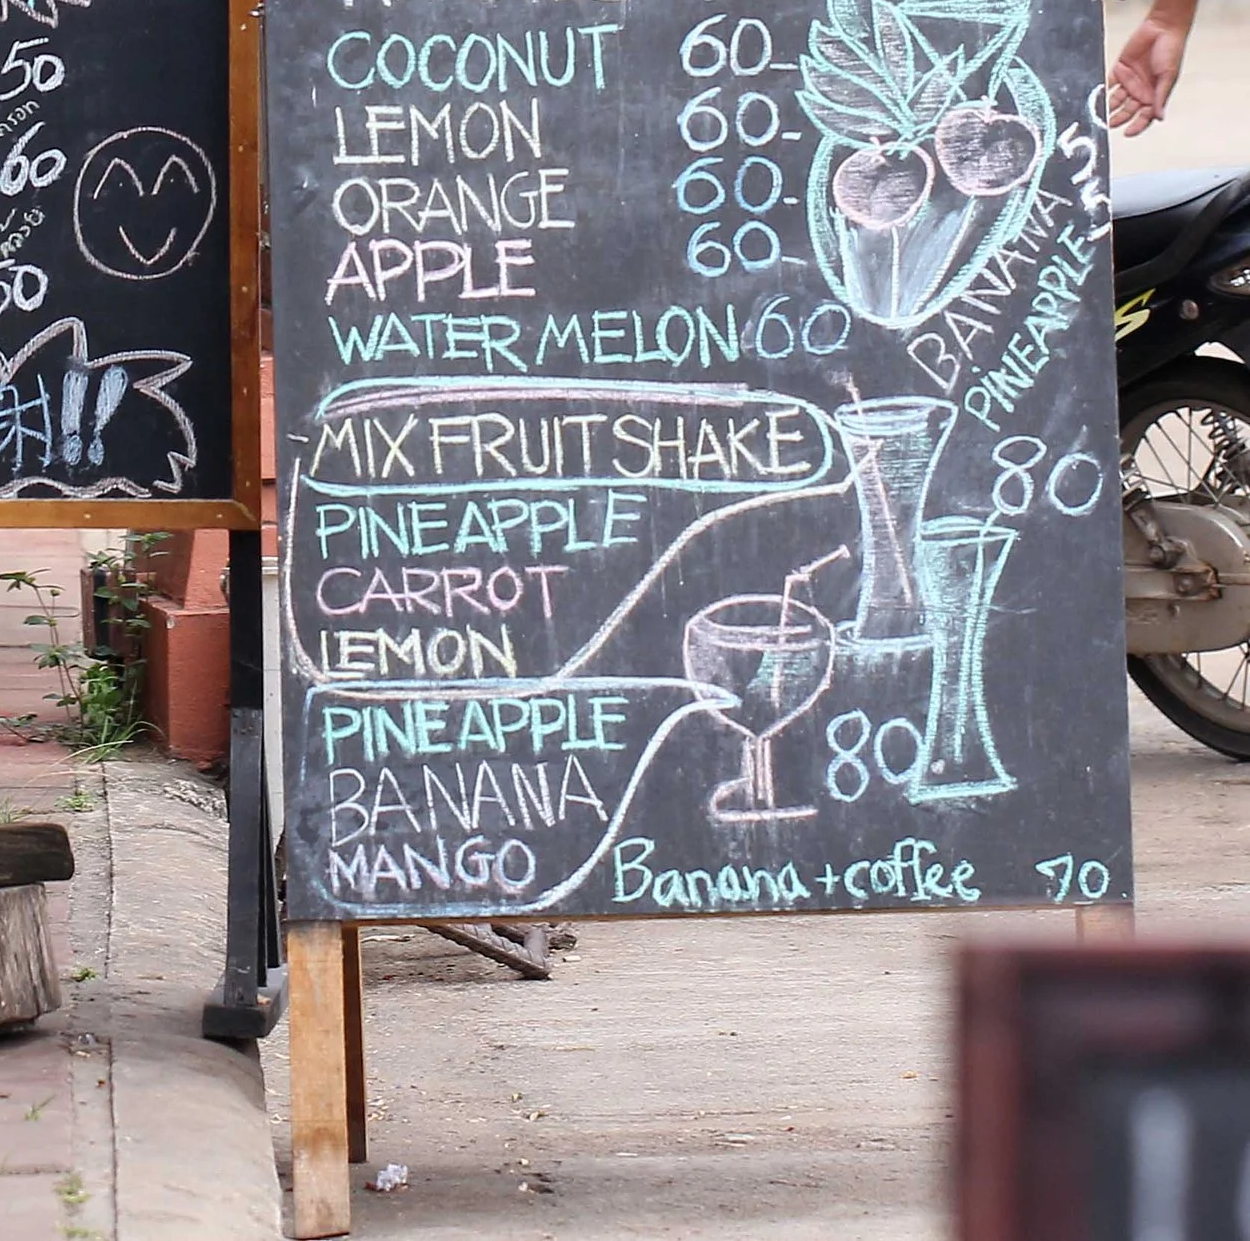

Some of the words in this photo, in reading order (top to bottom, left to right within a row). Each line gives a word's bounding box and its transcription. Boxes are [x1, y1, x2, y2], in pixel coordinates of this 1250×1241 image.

[326, 23, 620, 93] COCONUT
[0, 121, 67, 196] 60
[333, 98, 543, 167] LEMON
[331, 168, 575, 236] ORANGE
[324, 238, 537, 305] APPLE
[907, 188, 1072, 391] BANANA
[753, 294, 851, 360] 60
[964, 220, 1096, 433] PINEAPPLE
[309, 413, 420, 478] MIX
[428, 412, 608, 478] FRUIT
[611, 405, 812, 480] SHAKE
[991, 434, 1105, 517] 80
[315, 490, 647, 559] PINEAPPLE
[315, 564, 570, 619] CARROT
[319, 622, 518, 679] LEMON
[321, 695, 630, 765] PINEAPPLE
[825, 709, 924, 803] 80
[329, 753, 610, 847] BANANA
[327, 833, 537, 895] MANGO
